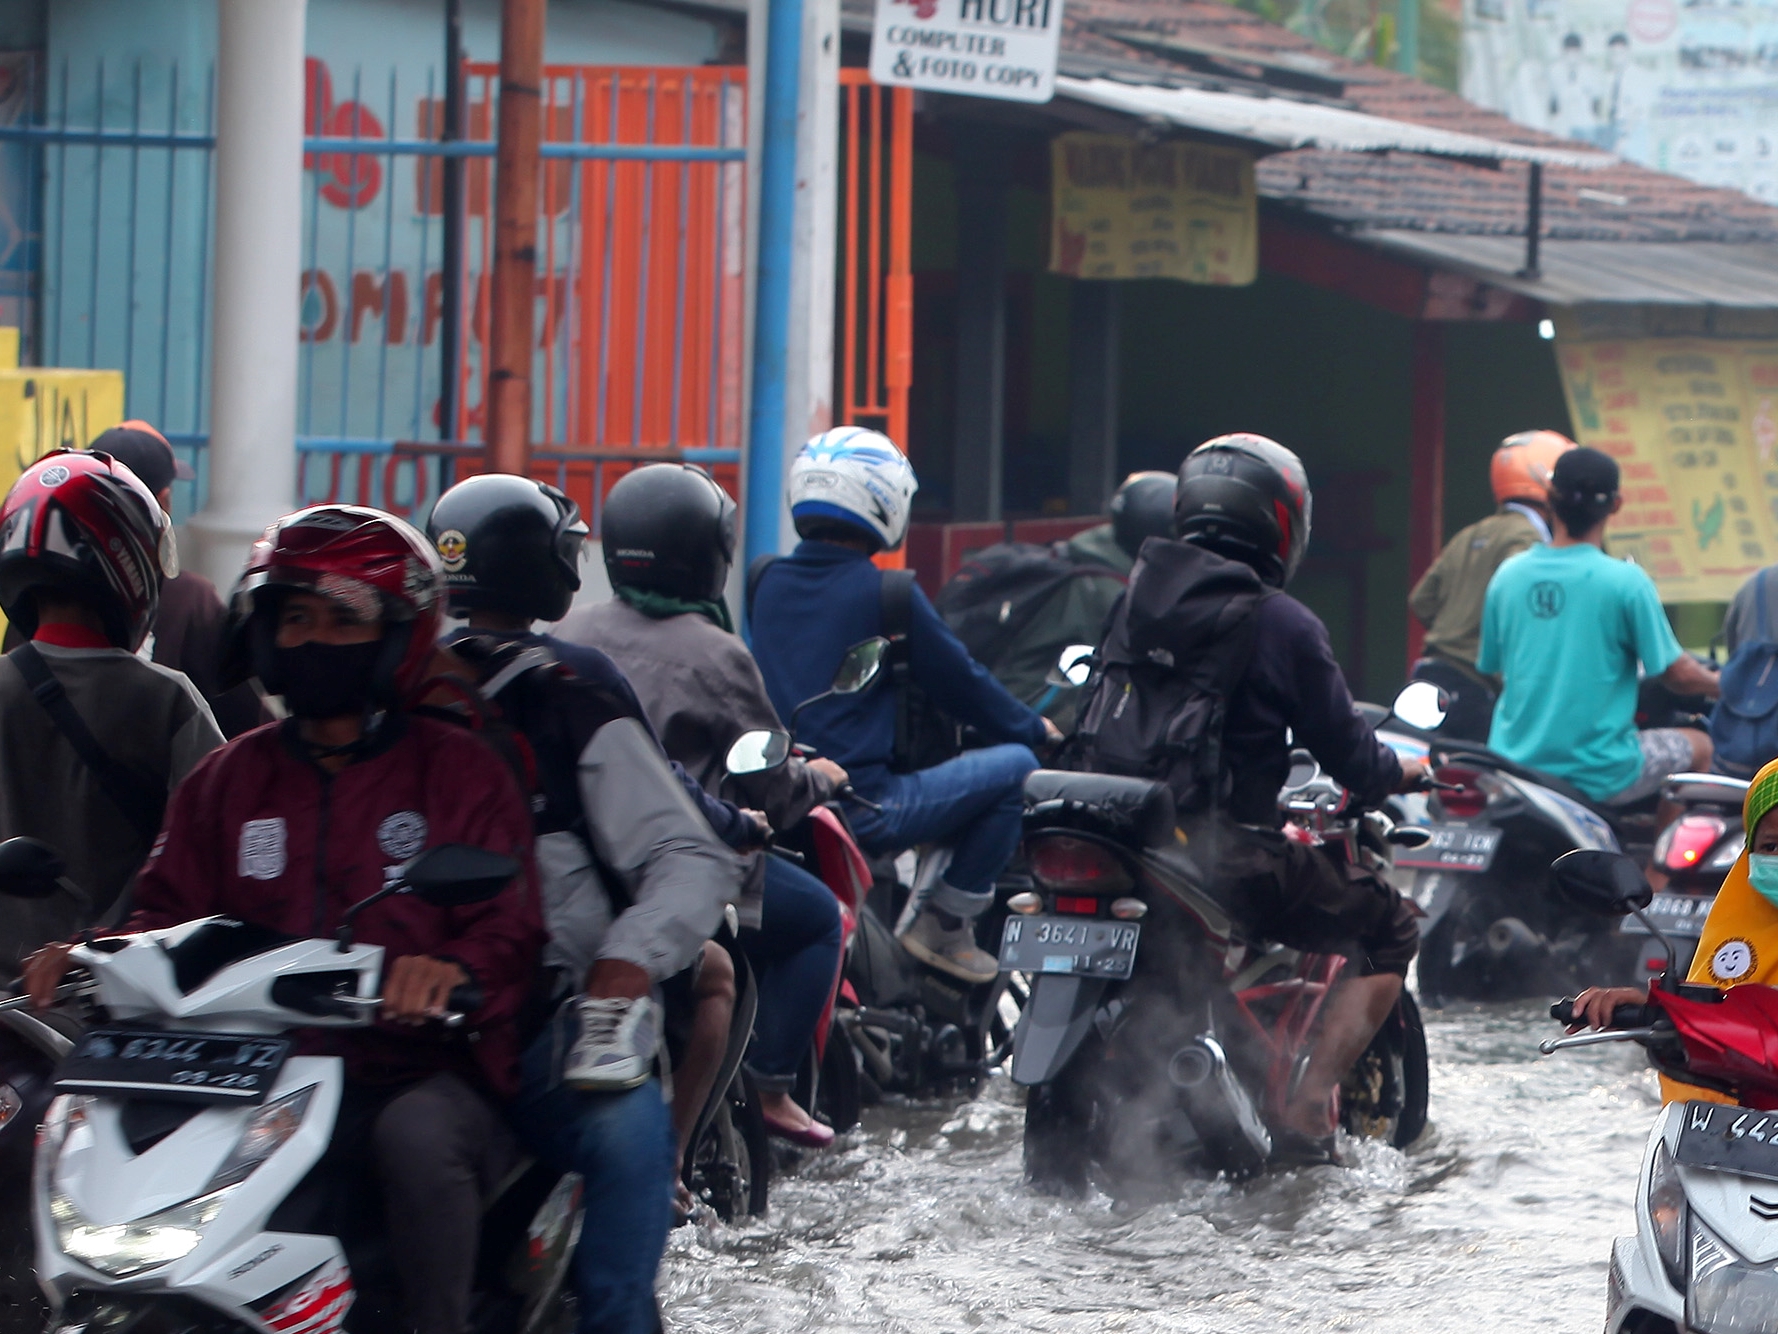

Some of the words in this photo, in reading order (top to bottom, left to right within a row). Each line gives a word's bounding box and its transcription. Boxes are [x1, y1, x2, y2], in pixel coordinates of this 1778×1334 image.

[887, 25, 1007, 56] COMPUTER
[892, 50, 911, 77] &
[919, 56, 977, 81] FOTO
[984, 64, 1043, 89] COPY
[1037, 922, 1087, 945] 3641
[1111, 928, 1135, 950] VR
[1690, 1105, 1714, 1131] W
